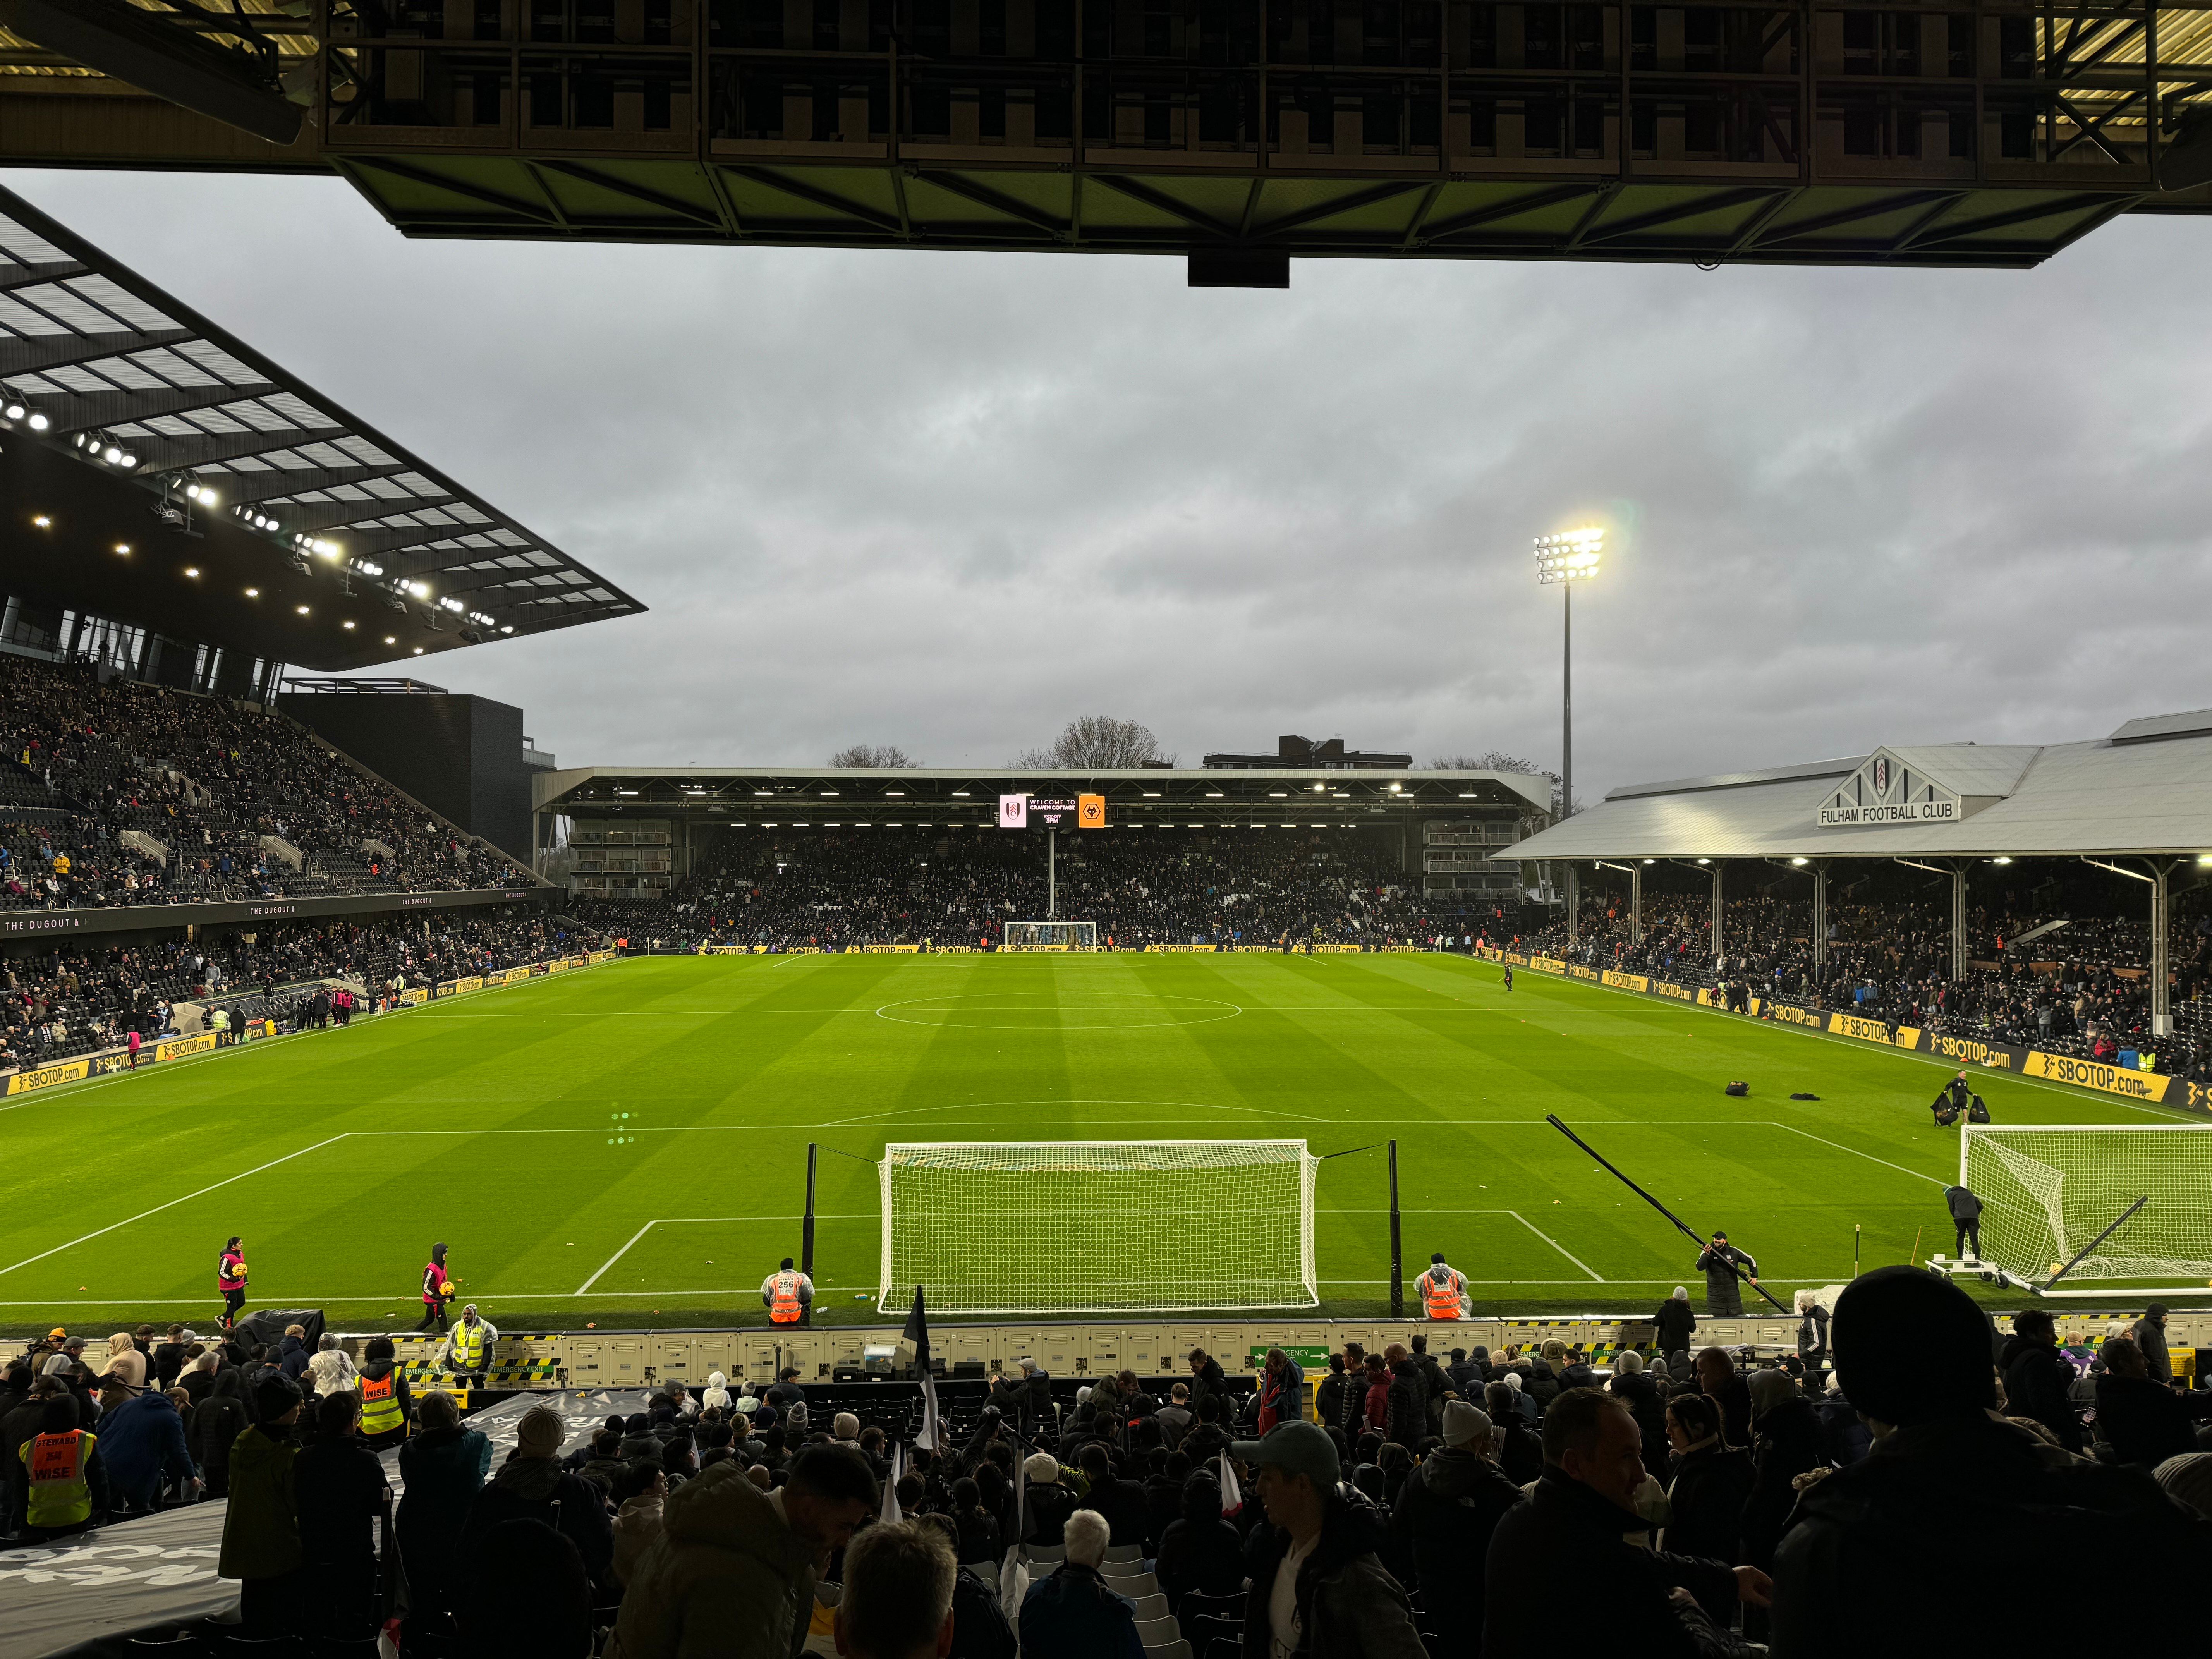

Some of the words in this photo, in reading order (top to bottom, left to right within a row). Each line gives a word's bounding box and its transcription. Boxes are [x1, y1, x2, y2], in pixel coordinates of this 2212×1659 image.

[1821, 809, 1858, 823] FULHAM
[1863, 806, 1917, 821] FOOTBALL
[1923, 803, 1952, 818] CLUB
[5, 921, 23, 931] THE
[30, 919, 69, 929] DUGOUT
[74, 918, 79, 926] &
[1573, 965, 1597, 981] SBOTOP.com
[1659, 982, 1691, 1001] SBOTOP.com
[1775, 1004, 1820, 1028] SBOTOP.com
[1850, 1019, 1905, 1046] SBOTOP.m
[171, 1039, 210, 1056] SBOTOP.com
[1942, 1037, 2010, 1068] SBOTOPcom
[29, 1068, 79, 1088] SBOTOP.com
[2058, 1059, 2144, 1096] SBOTOP.com
[366, 1388, 388, 1398] WISE
[34, 1467, 71, 1480] WISE
